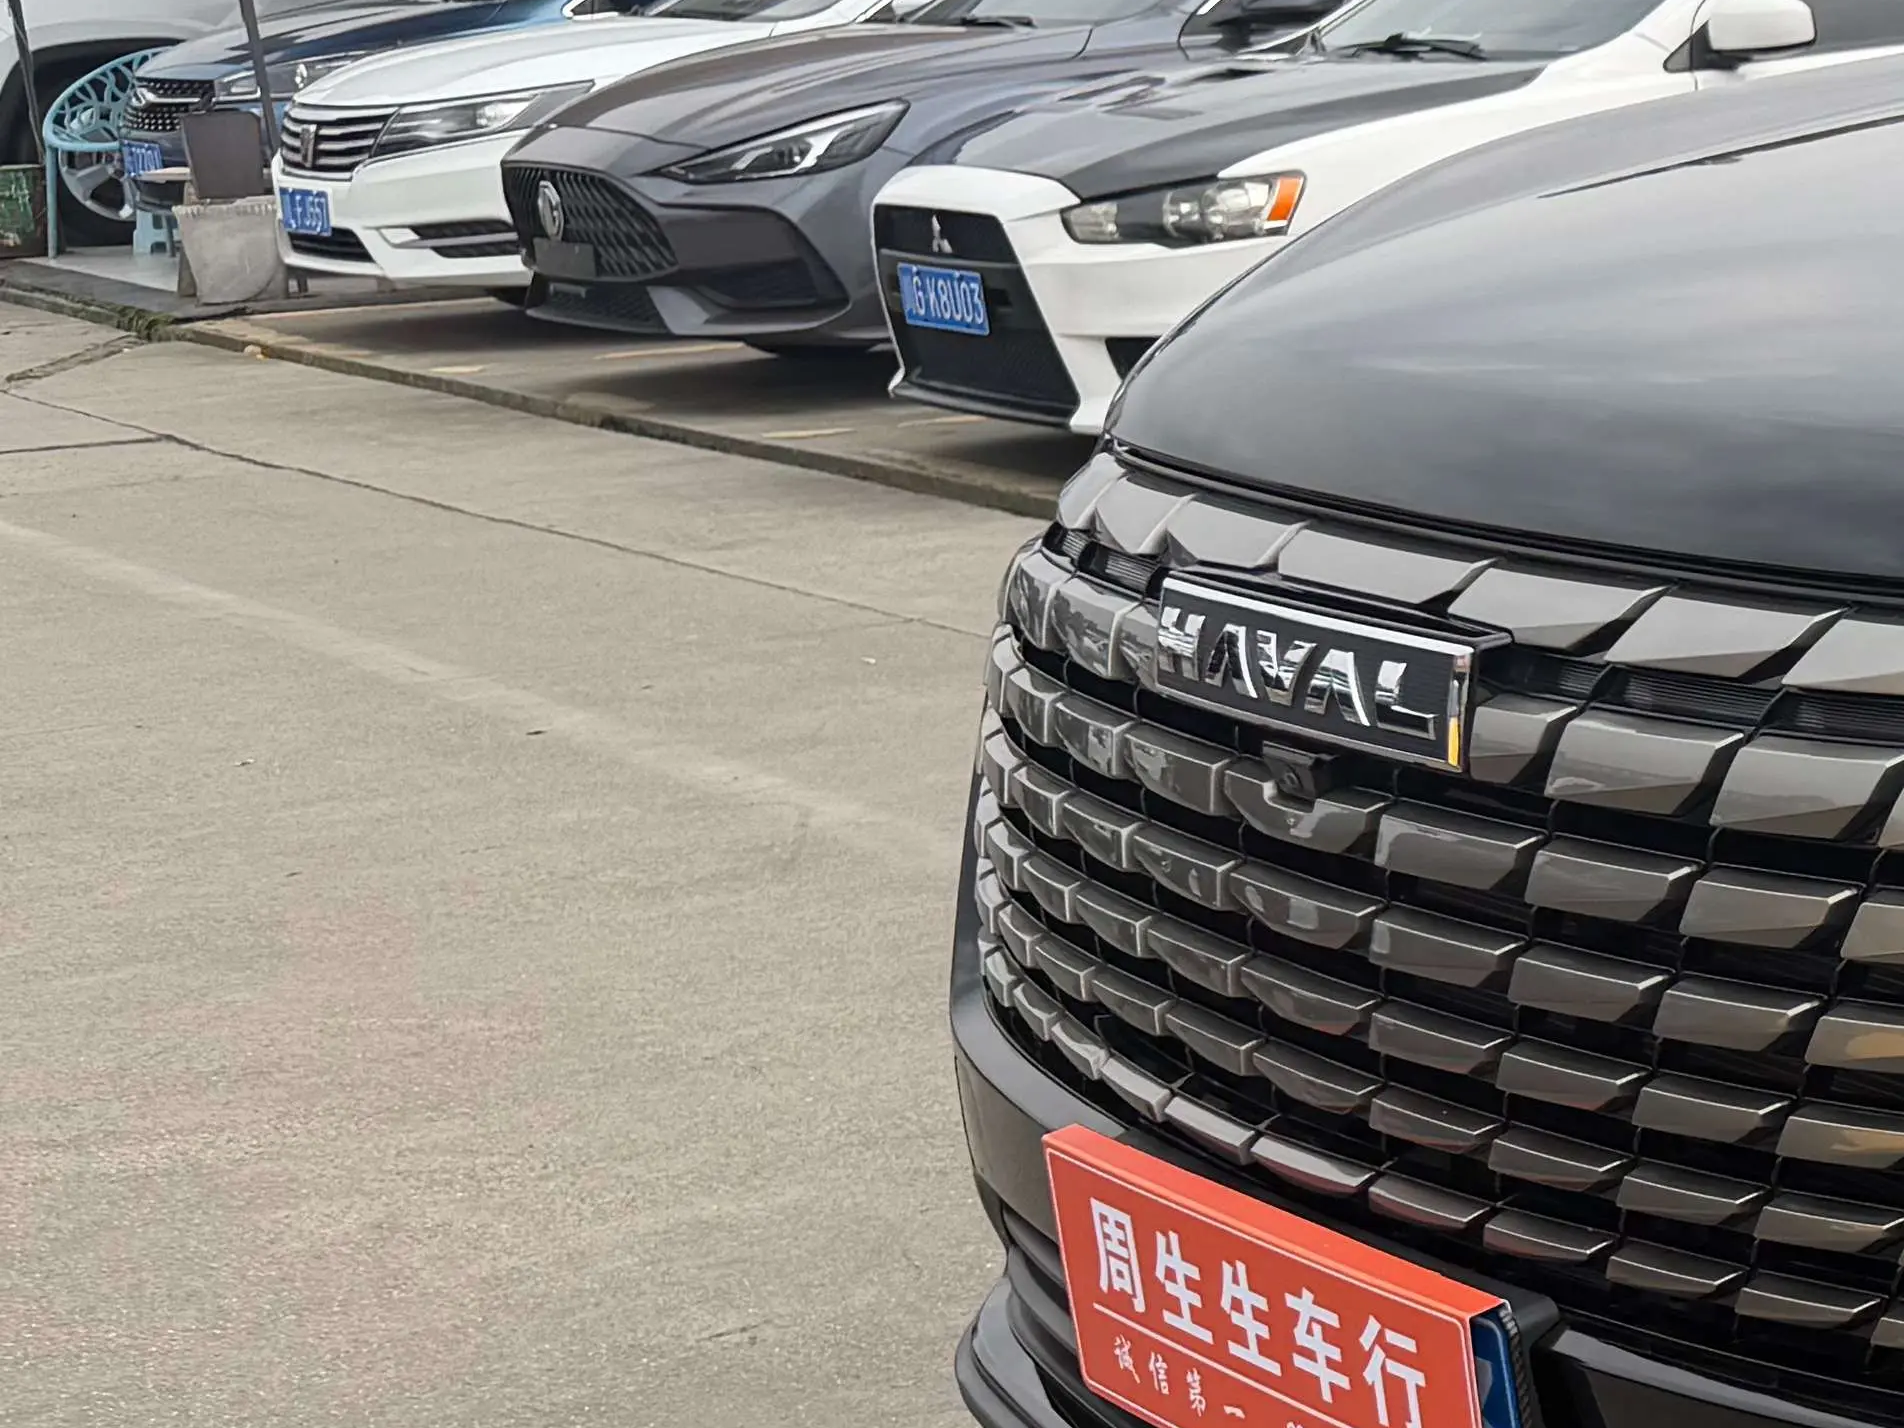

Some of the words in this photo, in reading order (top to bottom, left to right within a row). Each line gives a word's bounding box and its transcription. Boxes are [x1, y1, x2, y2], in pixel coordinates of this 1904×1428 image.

[901, 274, 985, 325] GK8U03
[1157, 605, 1437, 740] HAVAL
[1113, 1334, 1246, 1421] 诚信第一
